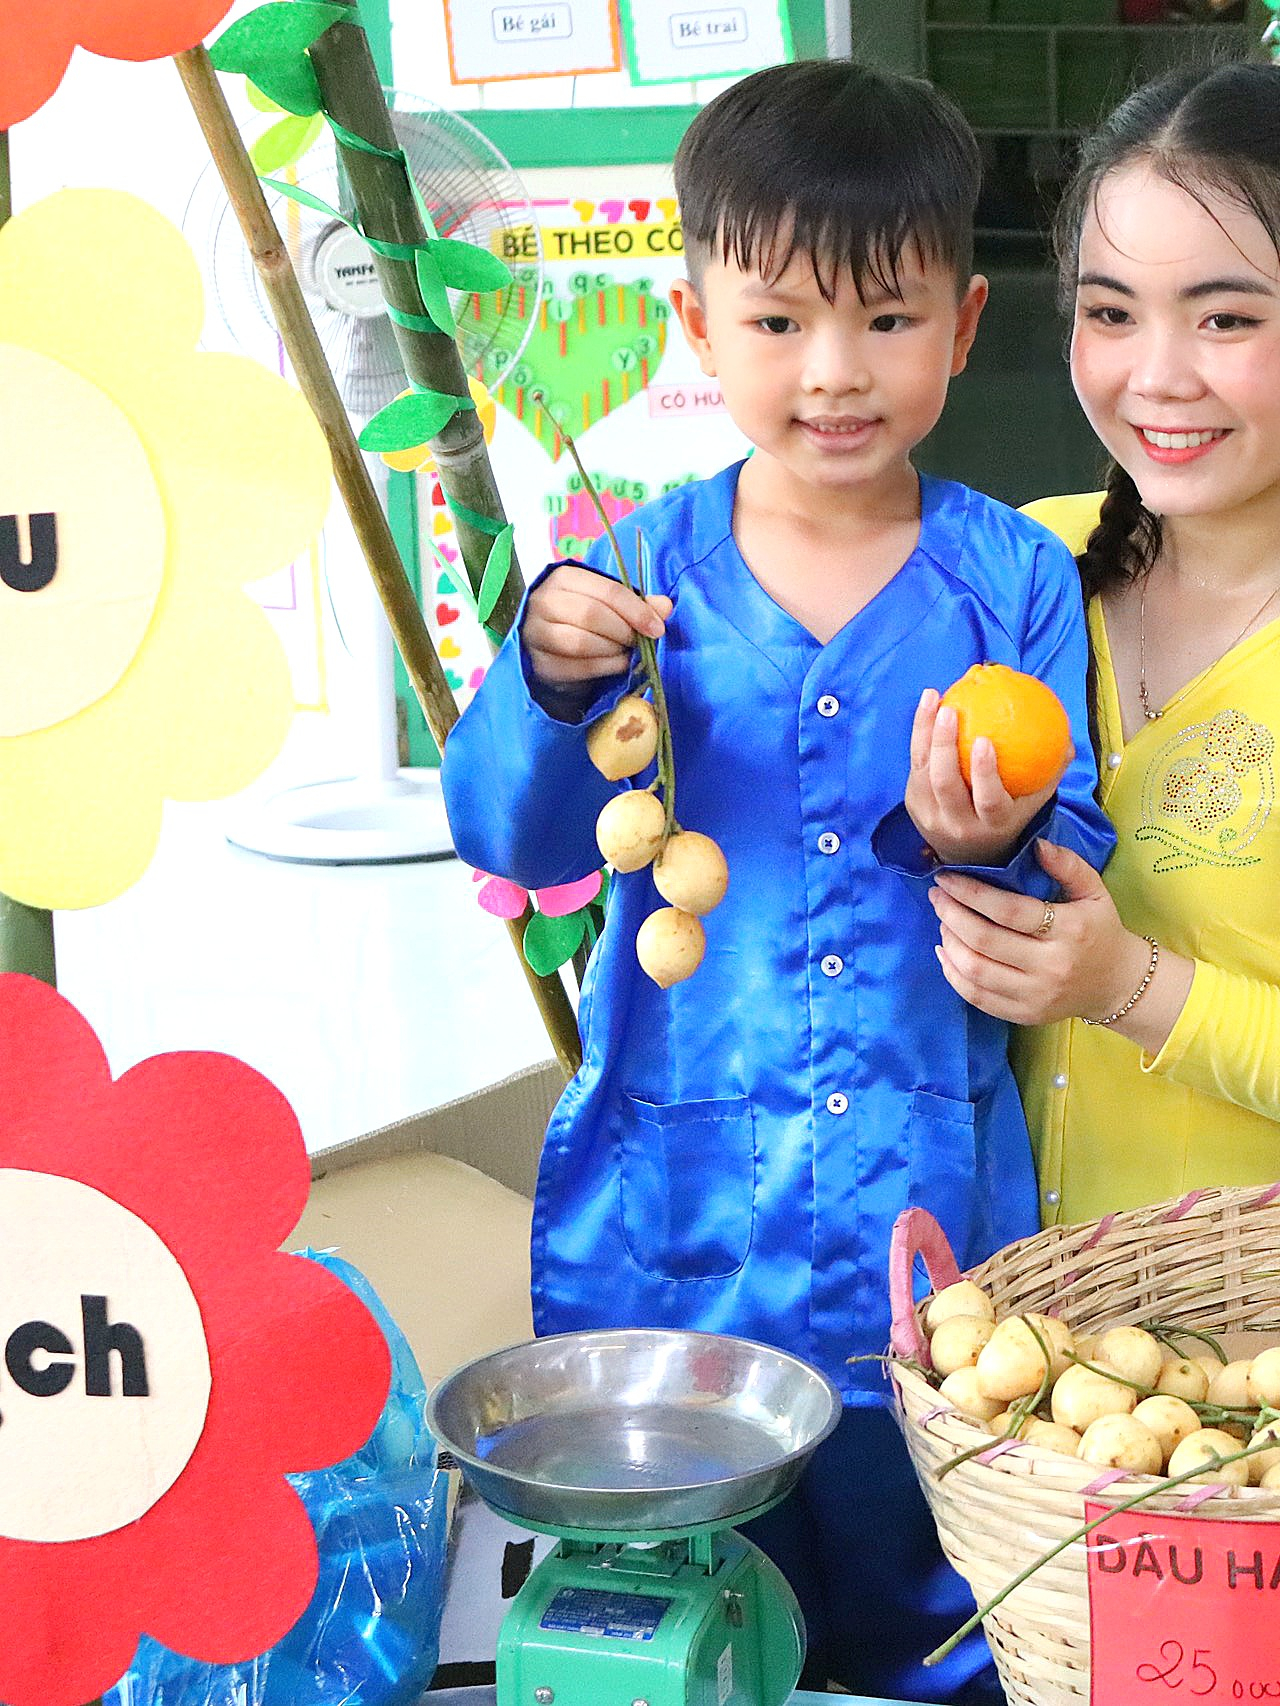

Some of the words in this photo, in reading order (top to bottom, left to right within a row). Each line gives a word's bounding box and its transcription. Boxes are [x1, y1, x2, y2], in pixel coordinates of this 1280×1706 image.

[502, 15, 525, 33] Bé
[530, 14, 557, 34] gái
[679, 22, 700, 38] Bé
[502, 225, 539, 258] BÉ
[553, 230, 634, 256] THEO
[660, 390, 686, 409] CÔ
[2, 1294, 150, 1399] ch
[1096, 1532, 1203, 1585] DÂU
